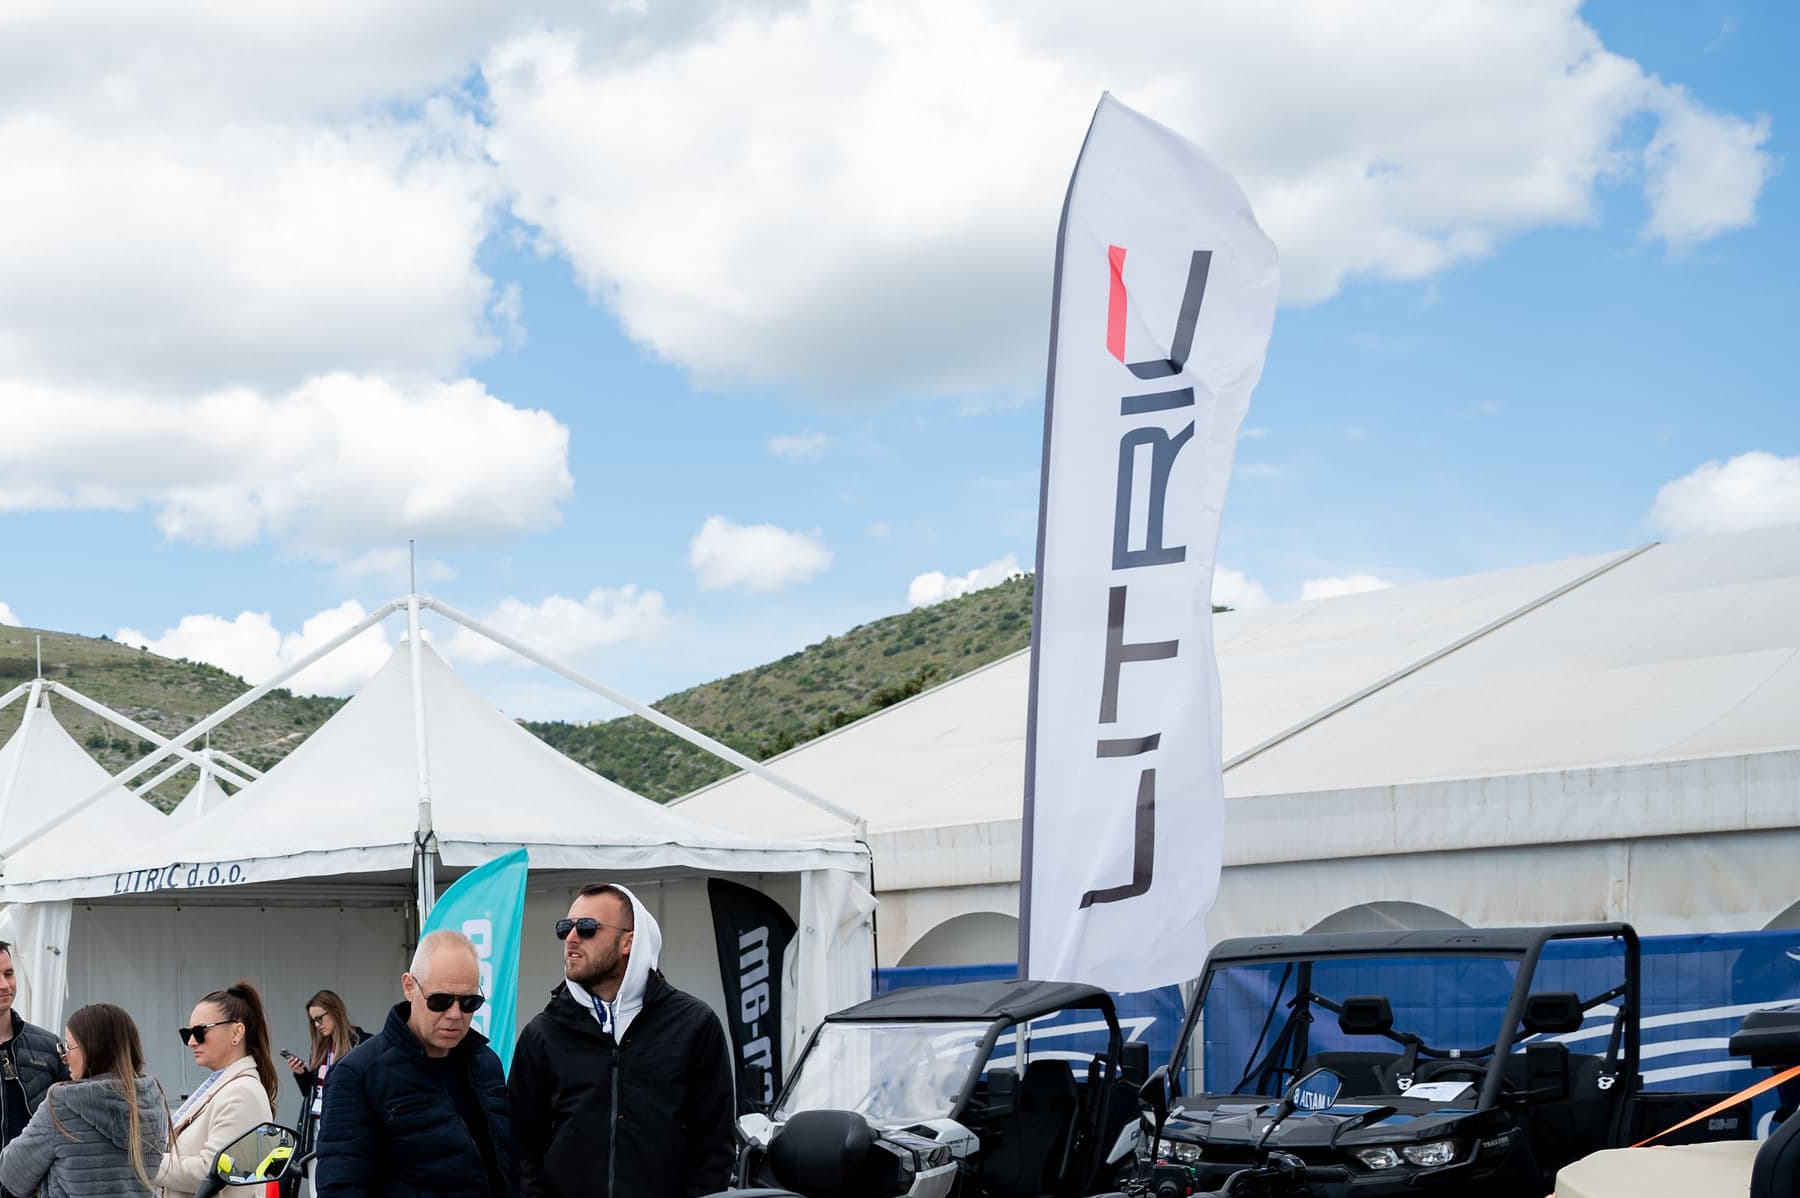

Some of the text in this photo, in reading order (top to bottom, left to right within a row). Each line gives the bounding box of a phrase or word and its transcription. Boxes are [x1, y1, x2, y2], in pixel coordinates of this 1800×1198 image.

[1079, 245, 1213, 909] LITRIC
[113, 862, 247, 894] LITRIC d.o.o.
